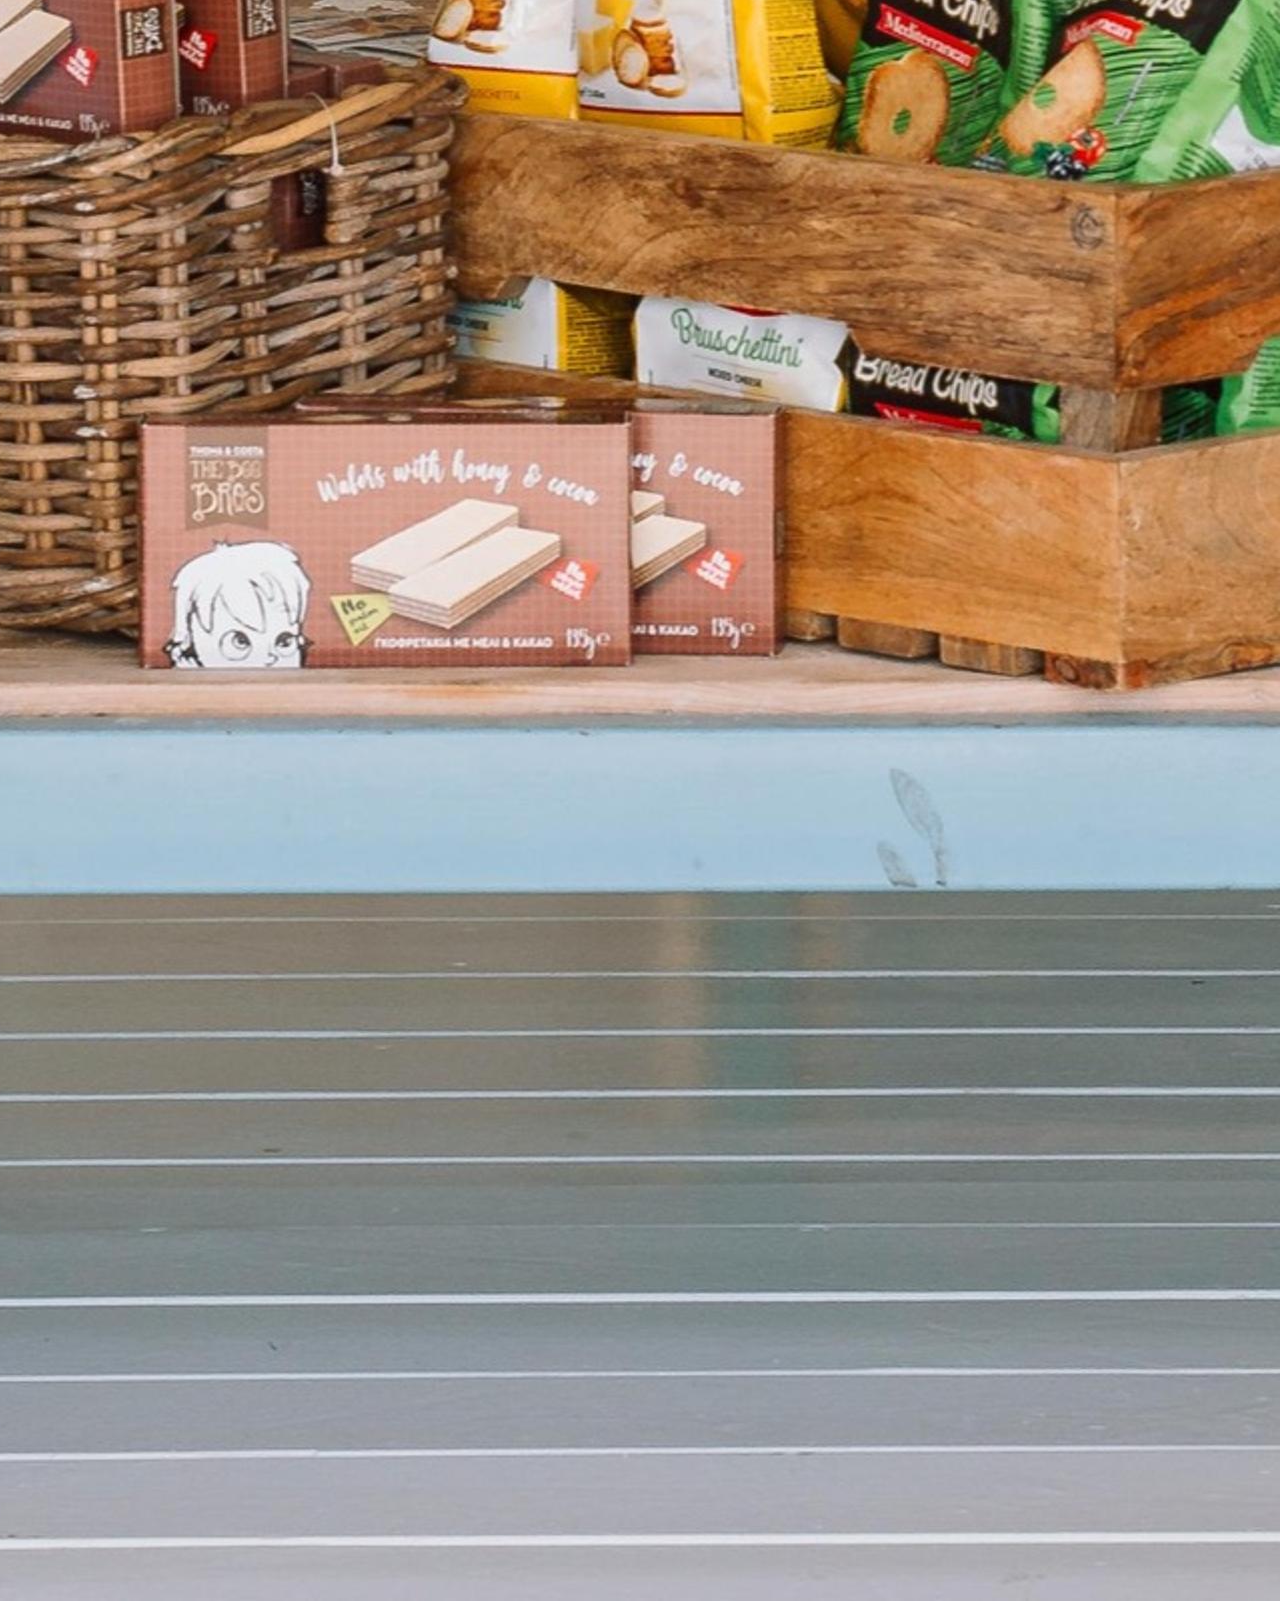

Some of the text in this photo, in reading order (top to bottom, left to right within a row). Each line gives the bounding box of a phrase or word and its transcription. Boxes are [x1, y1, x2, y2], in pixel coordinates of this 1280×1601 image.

[670, 307, 805, 370] Bruschettini
[931, 365, 998, 416] Chips
[392, 449, 447, 485] with
[451, 450, 513, 495] honey
[521, 463, 542, 489] &
[546, 474, 601, 506] cocoa
[668, 452, 746, 497] & cocoa
